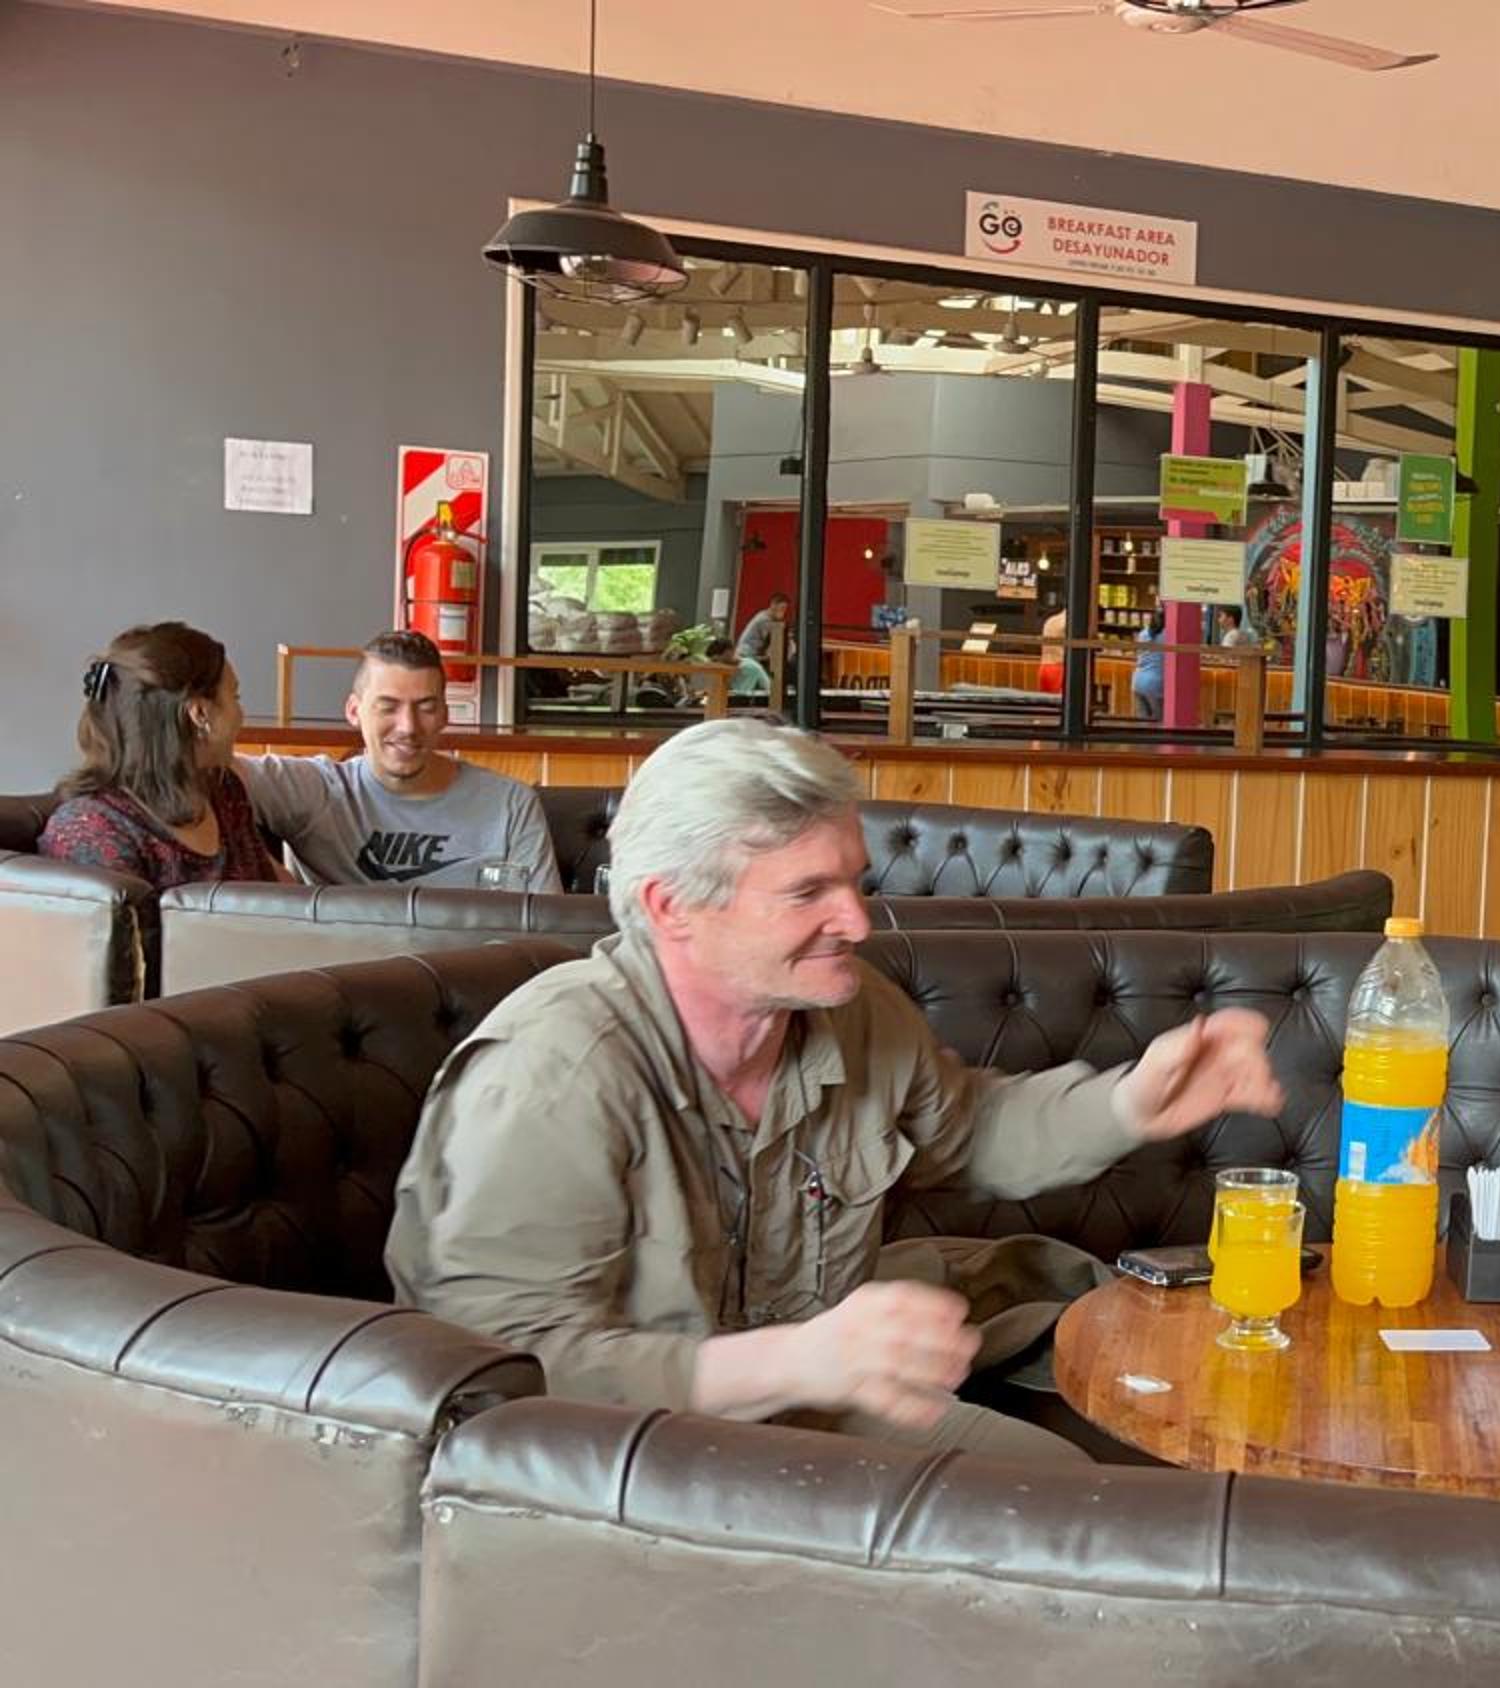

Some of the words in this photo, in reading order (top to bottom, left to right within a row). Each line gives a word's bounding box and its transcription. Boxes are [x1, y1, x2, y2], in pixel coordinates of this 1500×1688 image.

[1047, 216, 1131, 240] BREAKFAST
[1136, 228, 1176, 246] AREA
[1053, 238, 1169, 266] DESAYUNADOR
[370, 830, 450, 866] NIKE
